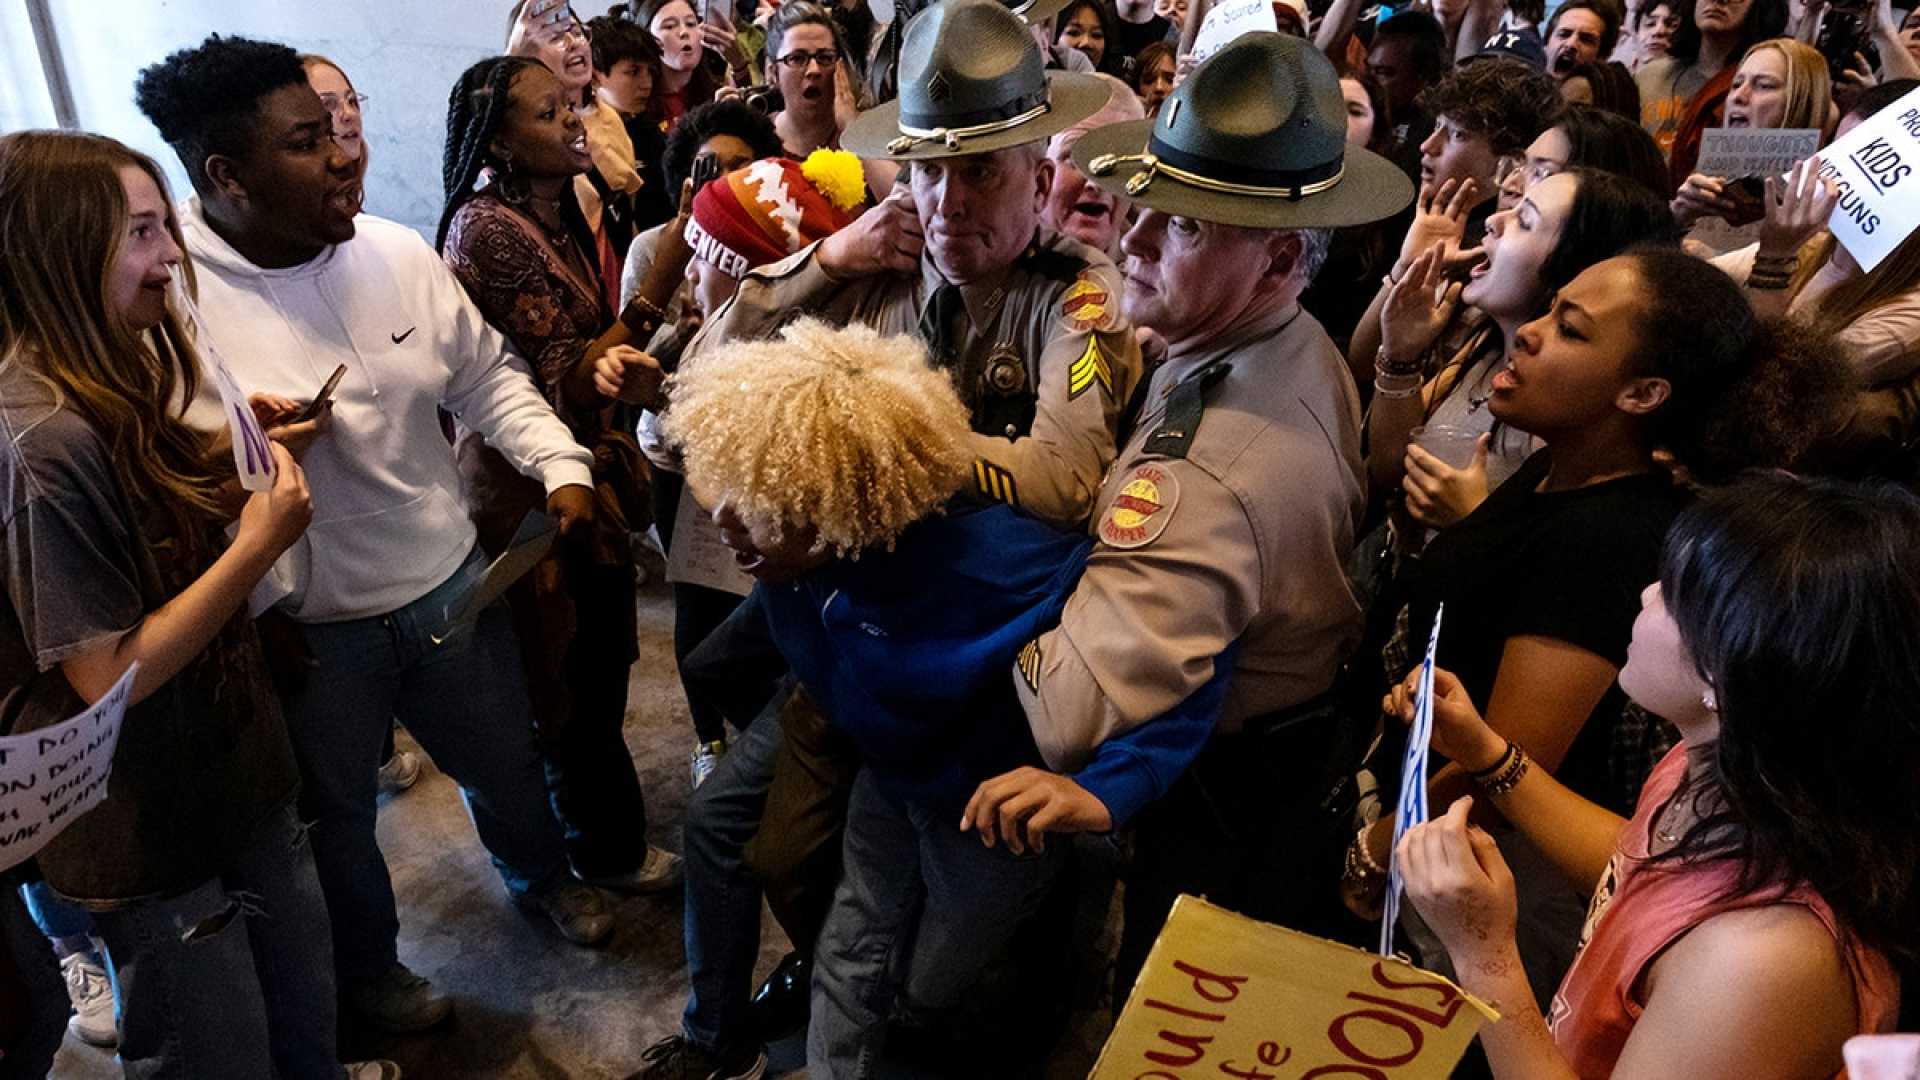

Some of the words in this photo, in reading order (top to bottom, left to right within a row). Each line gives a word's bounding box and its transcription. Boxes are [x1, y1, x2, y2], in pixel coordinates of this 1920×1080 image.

[1484, 33, 1521, 49] NY
[1897, 107, 1920, 144] PRO
[1856, 137, 1912, 188] KIDS
